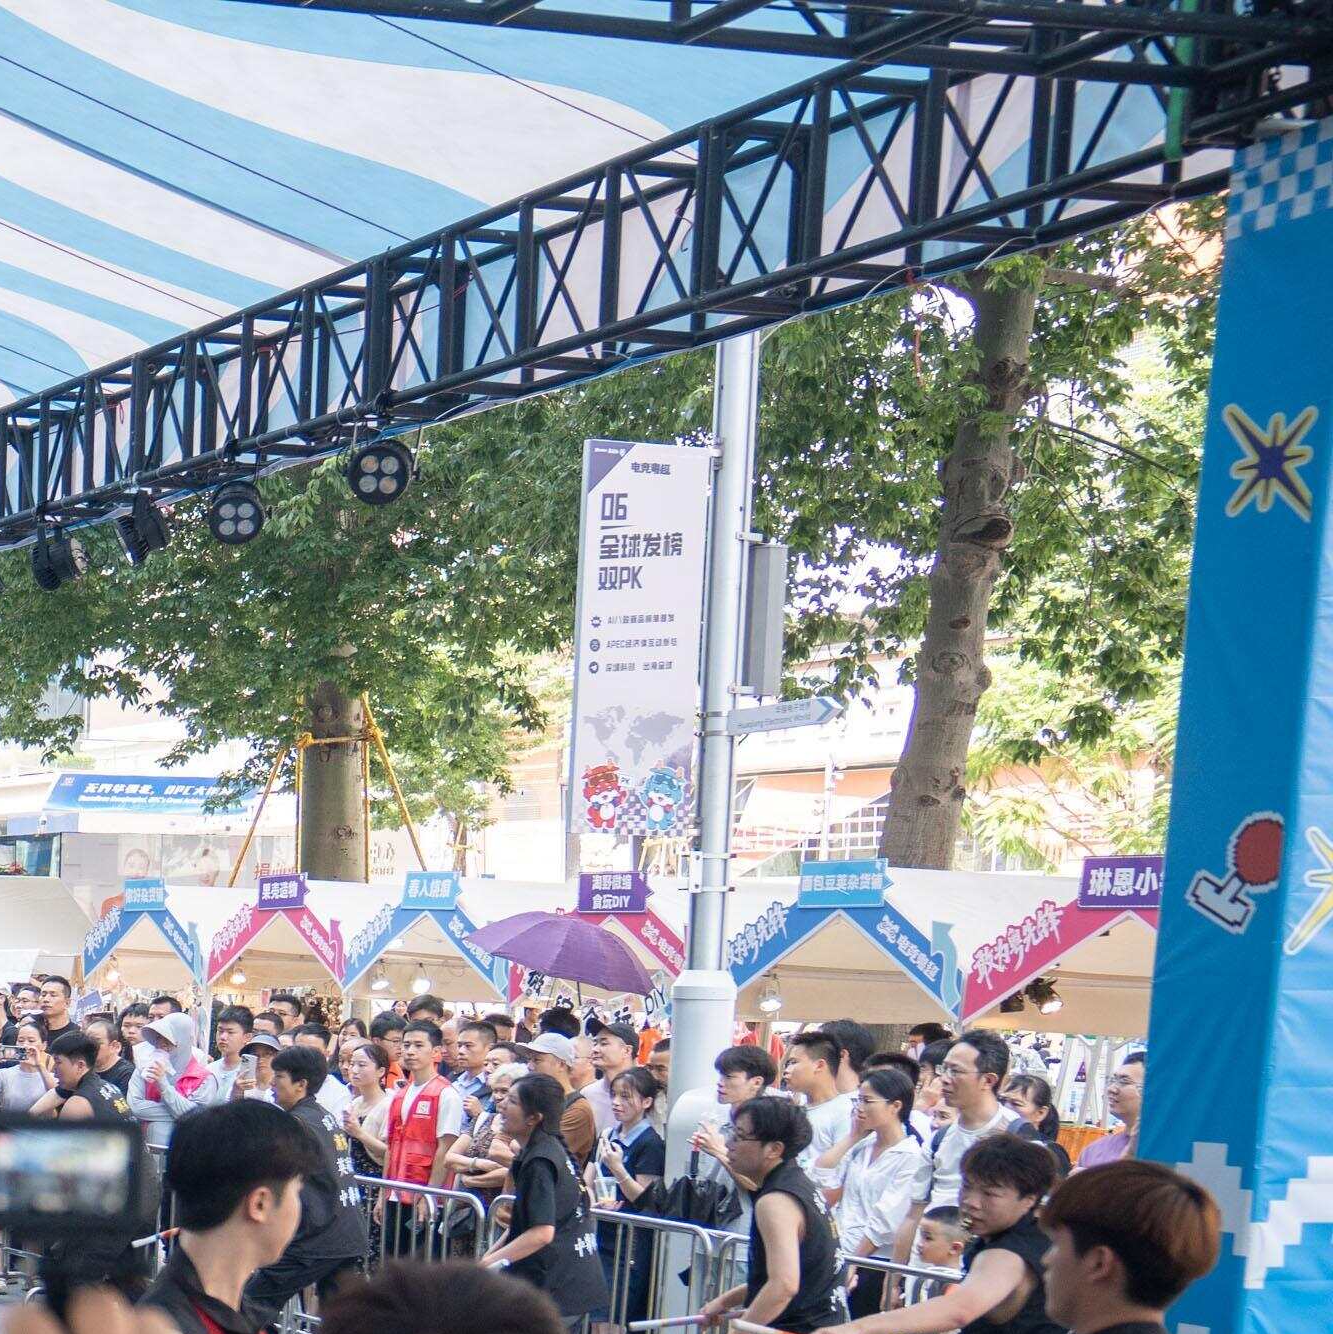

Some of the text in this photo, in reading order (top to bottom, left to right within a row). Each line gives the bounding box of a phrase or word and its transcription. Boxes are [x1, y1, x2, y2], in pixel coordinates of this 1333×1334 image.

[601, 493, 628, 520] 06
[599, 532, 683, 560] 全球发榜
[598, 566, 643, 590] 双PK
[1088, 866, 1163, 898] 琳恩小
